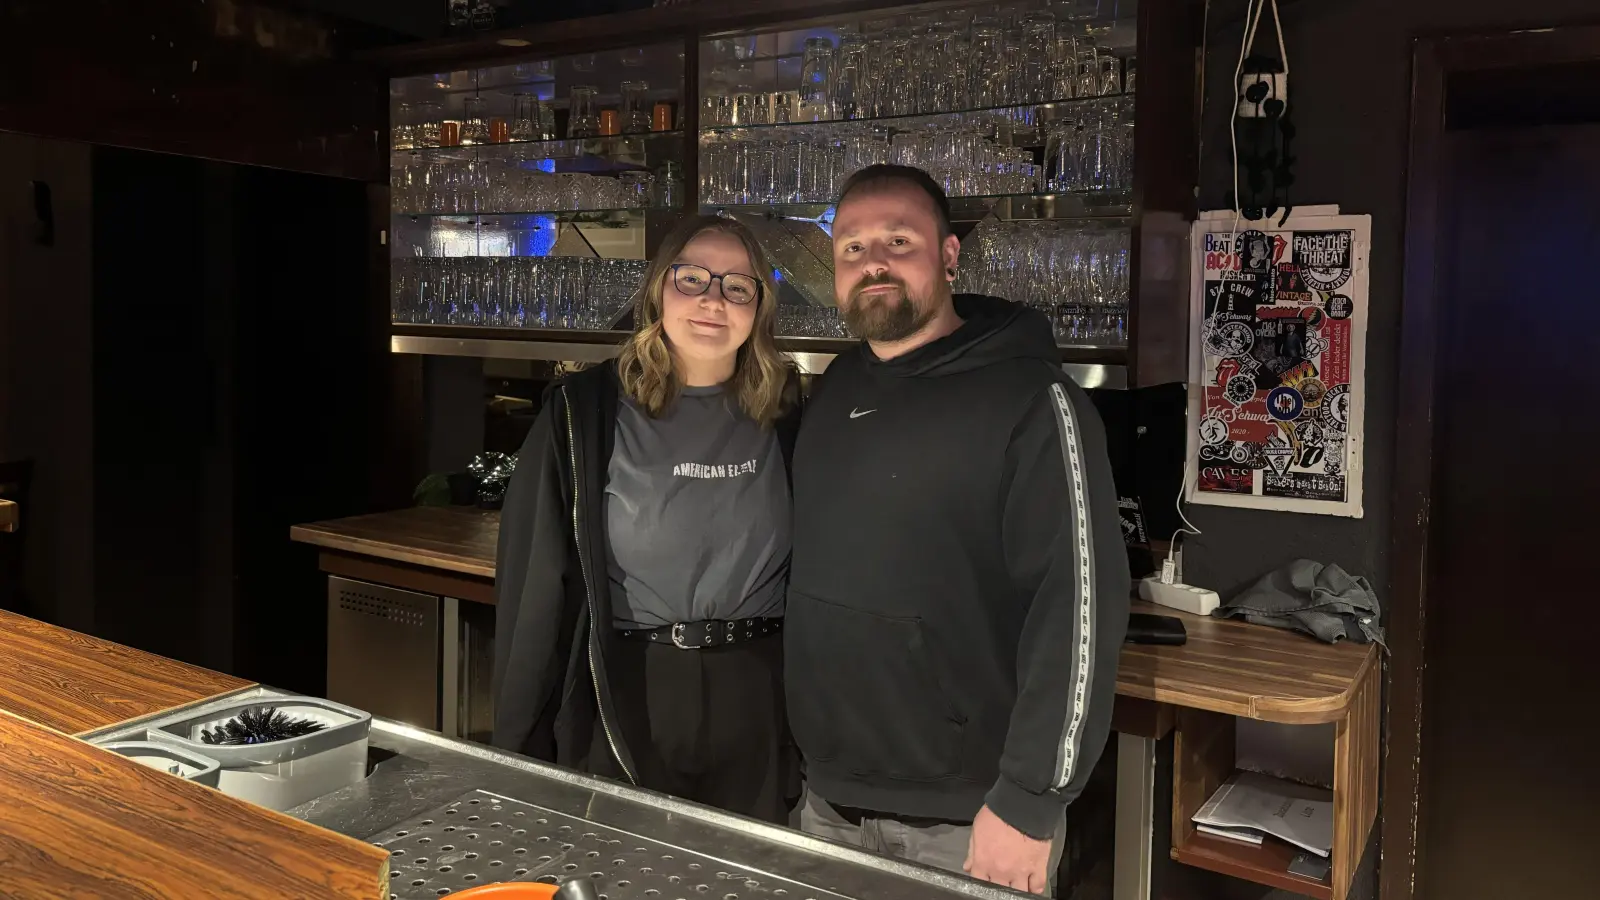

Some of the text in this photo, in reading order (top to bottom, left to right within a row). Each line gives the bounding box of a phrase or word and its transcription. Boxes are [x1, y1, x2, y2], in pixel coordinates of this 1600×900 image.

[1205, 234, 1234, 254] BEAT
[1294, 235, 1348, 251] FACE THE
[1300, 250, 1345, 264] THREAT
[1230, 283, 1254, 297] CREW
[1327, 388, 1344, 405] LUCKY
[1223, 406, 1270, 424] Schwa
[1321, 406, 1342, 432] TATTOO
[673, 462, 726, 479] AMERICAN
